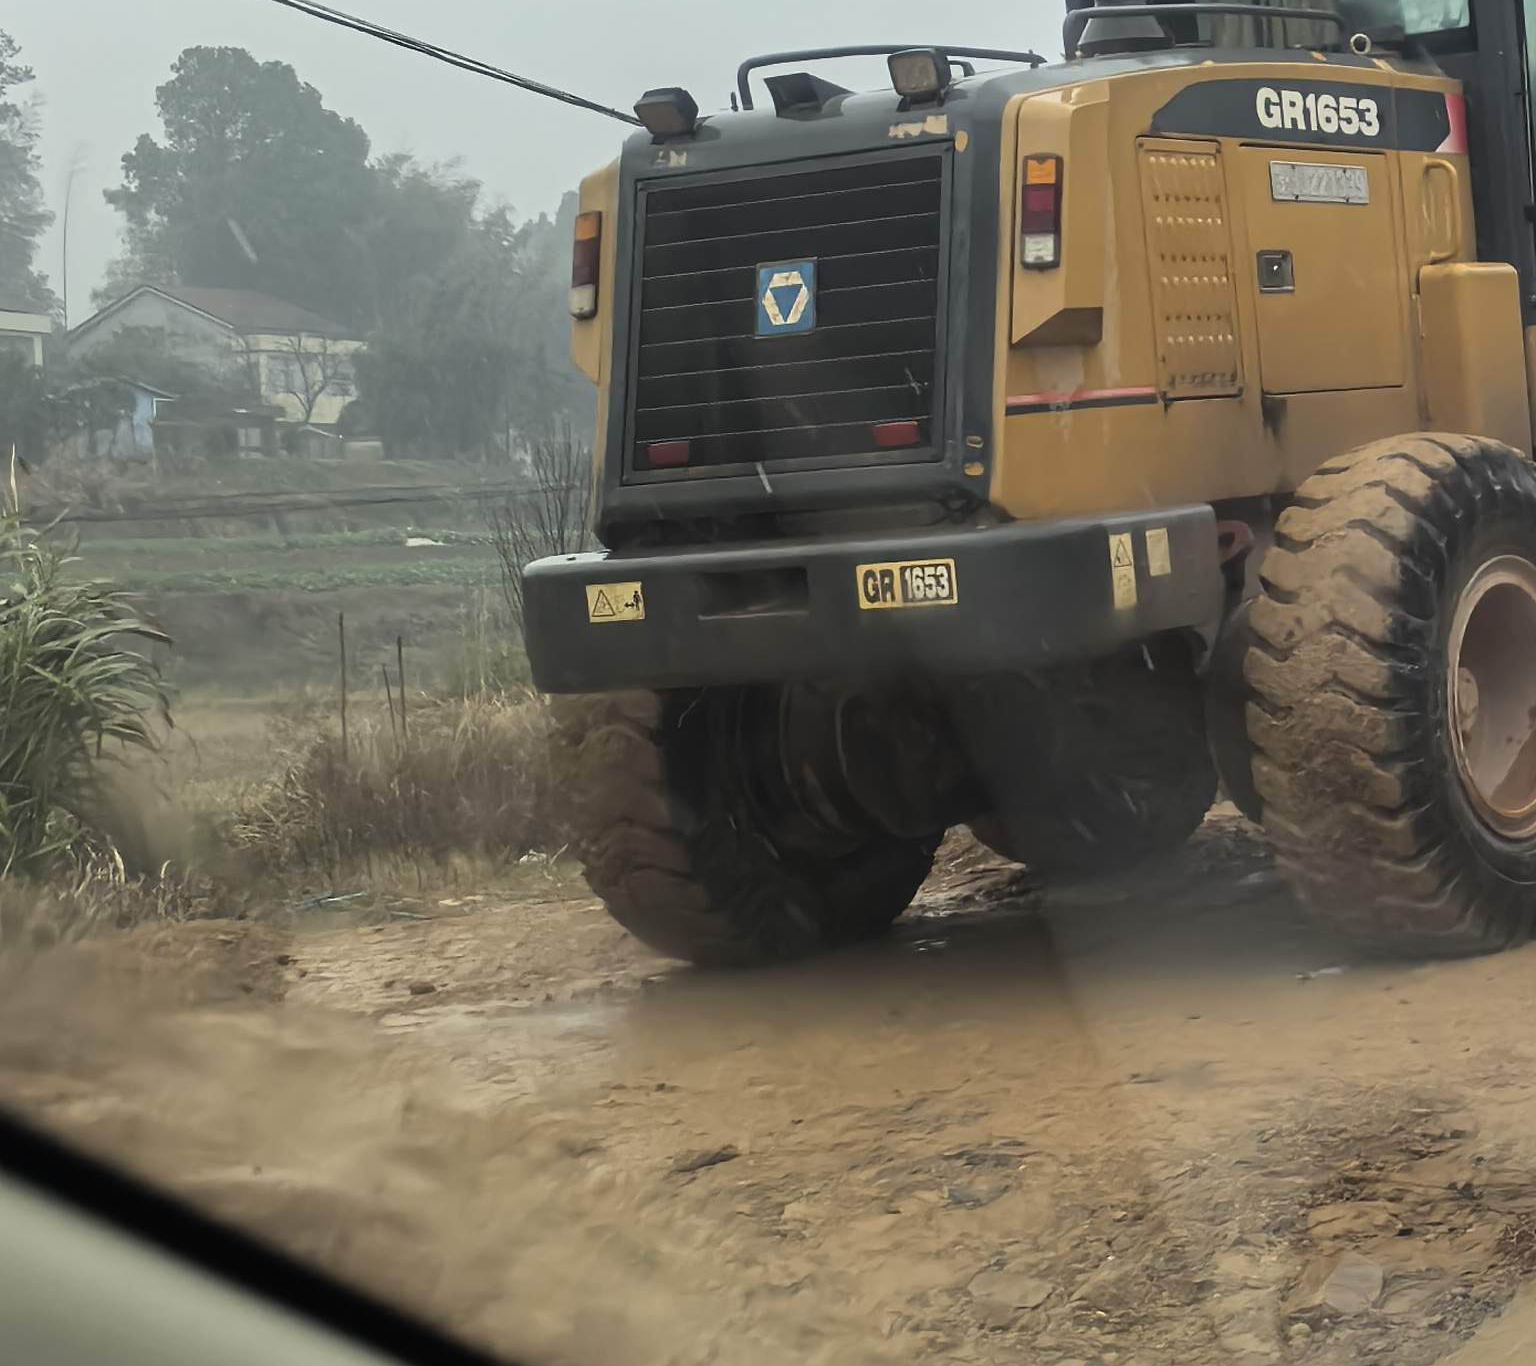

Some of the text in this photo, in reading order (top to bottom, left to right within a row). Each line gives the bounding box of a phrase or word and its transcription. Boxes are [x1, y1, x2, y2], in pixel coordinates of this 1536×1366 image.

[1256, 87, 1379, 136] GR1653
[863, 566, 950, 604] GR 1653
